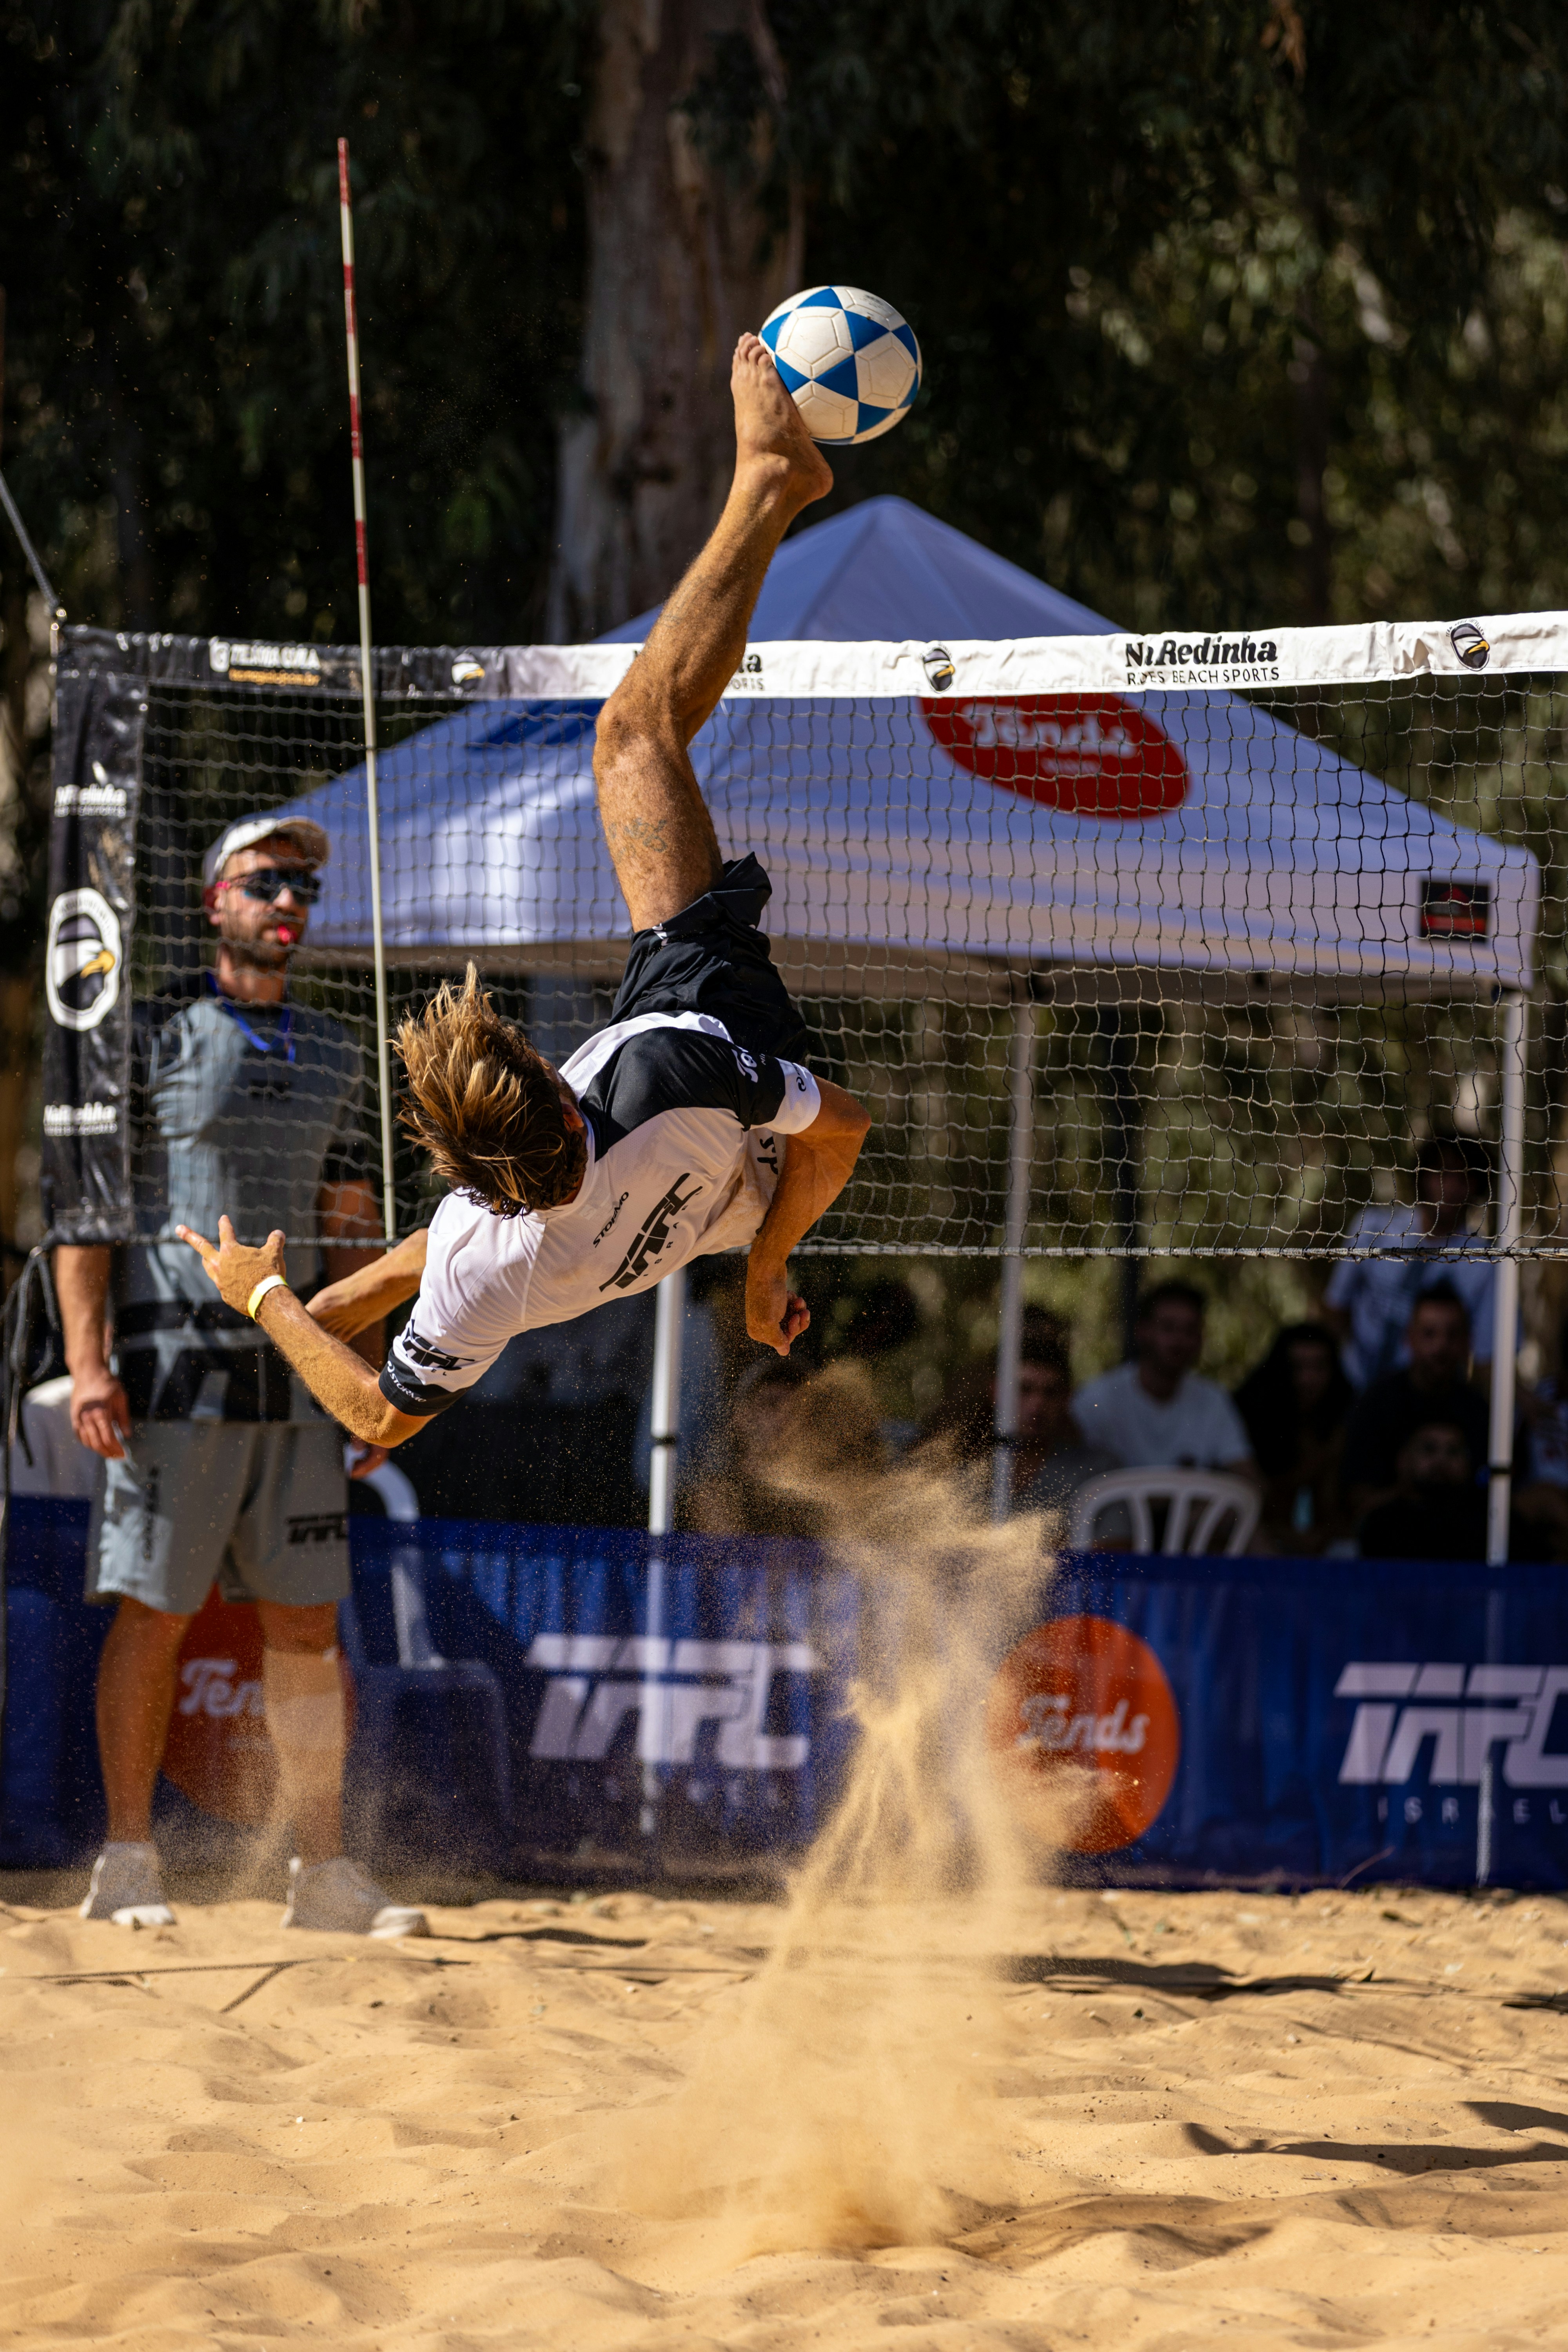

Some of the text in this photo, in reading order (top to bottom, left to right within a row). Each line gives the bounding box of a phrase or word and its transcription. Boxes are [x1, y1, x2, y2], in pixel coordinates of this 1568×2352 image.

[1127, 667, 1279, 685] RDES BEACH SPORTS
[593, 1192, 629, 1248] STORMO
[390, 1373, 426, 1402] STORMO
[1016, 1693, 1150, 1755] Tends
[1377, 1796, 1568, 1824] ISREL
